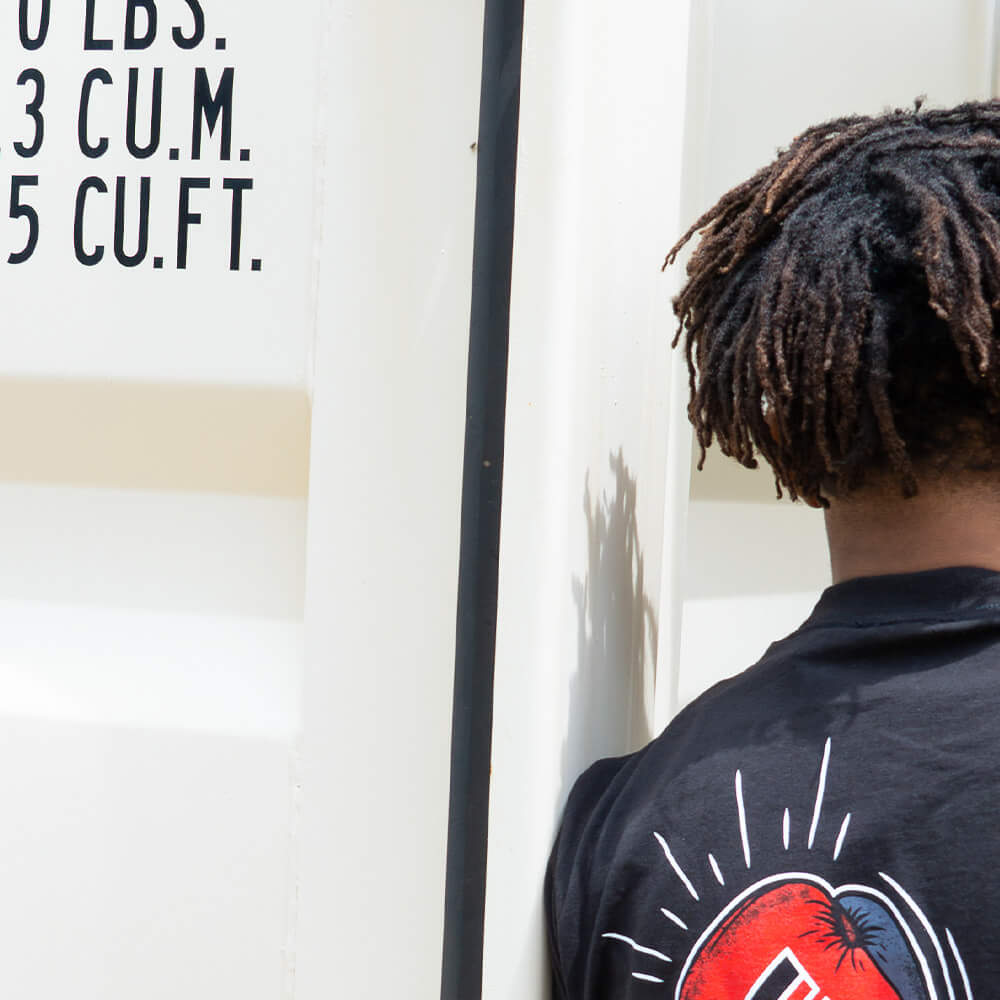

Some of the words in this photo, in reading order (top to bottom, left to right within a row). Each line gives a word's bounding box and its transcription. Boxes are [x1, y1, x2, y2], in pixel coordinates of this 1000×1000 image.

[83, 0, 226, 50] LBS.
[0, 67, 45, 158] 3
[77, 66, 250, 161] CU.M.
[8, 175, 39, 264] 5
[74, 175, 262, 271] CU.FT.
